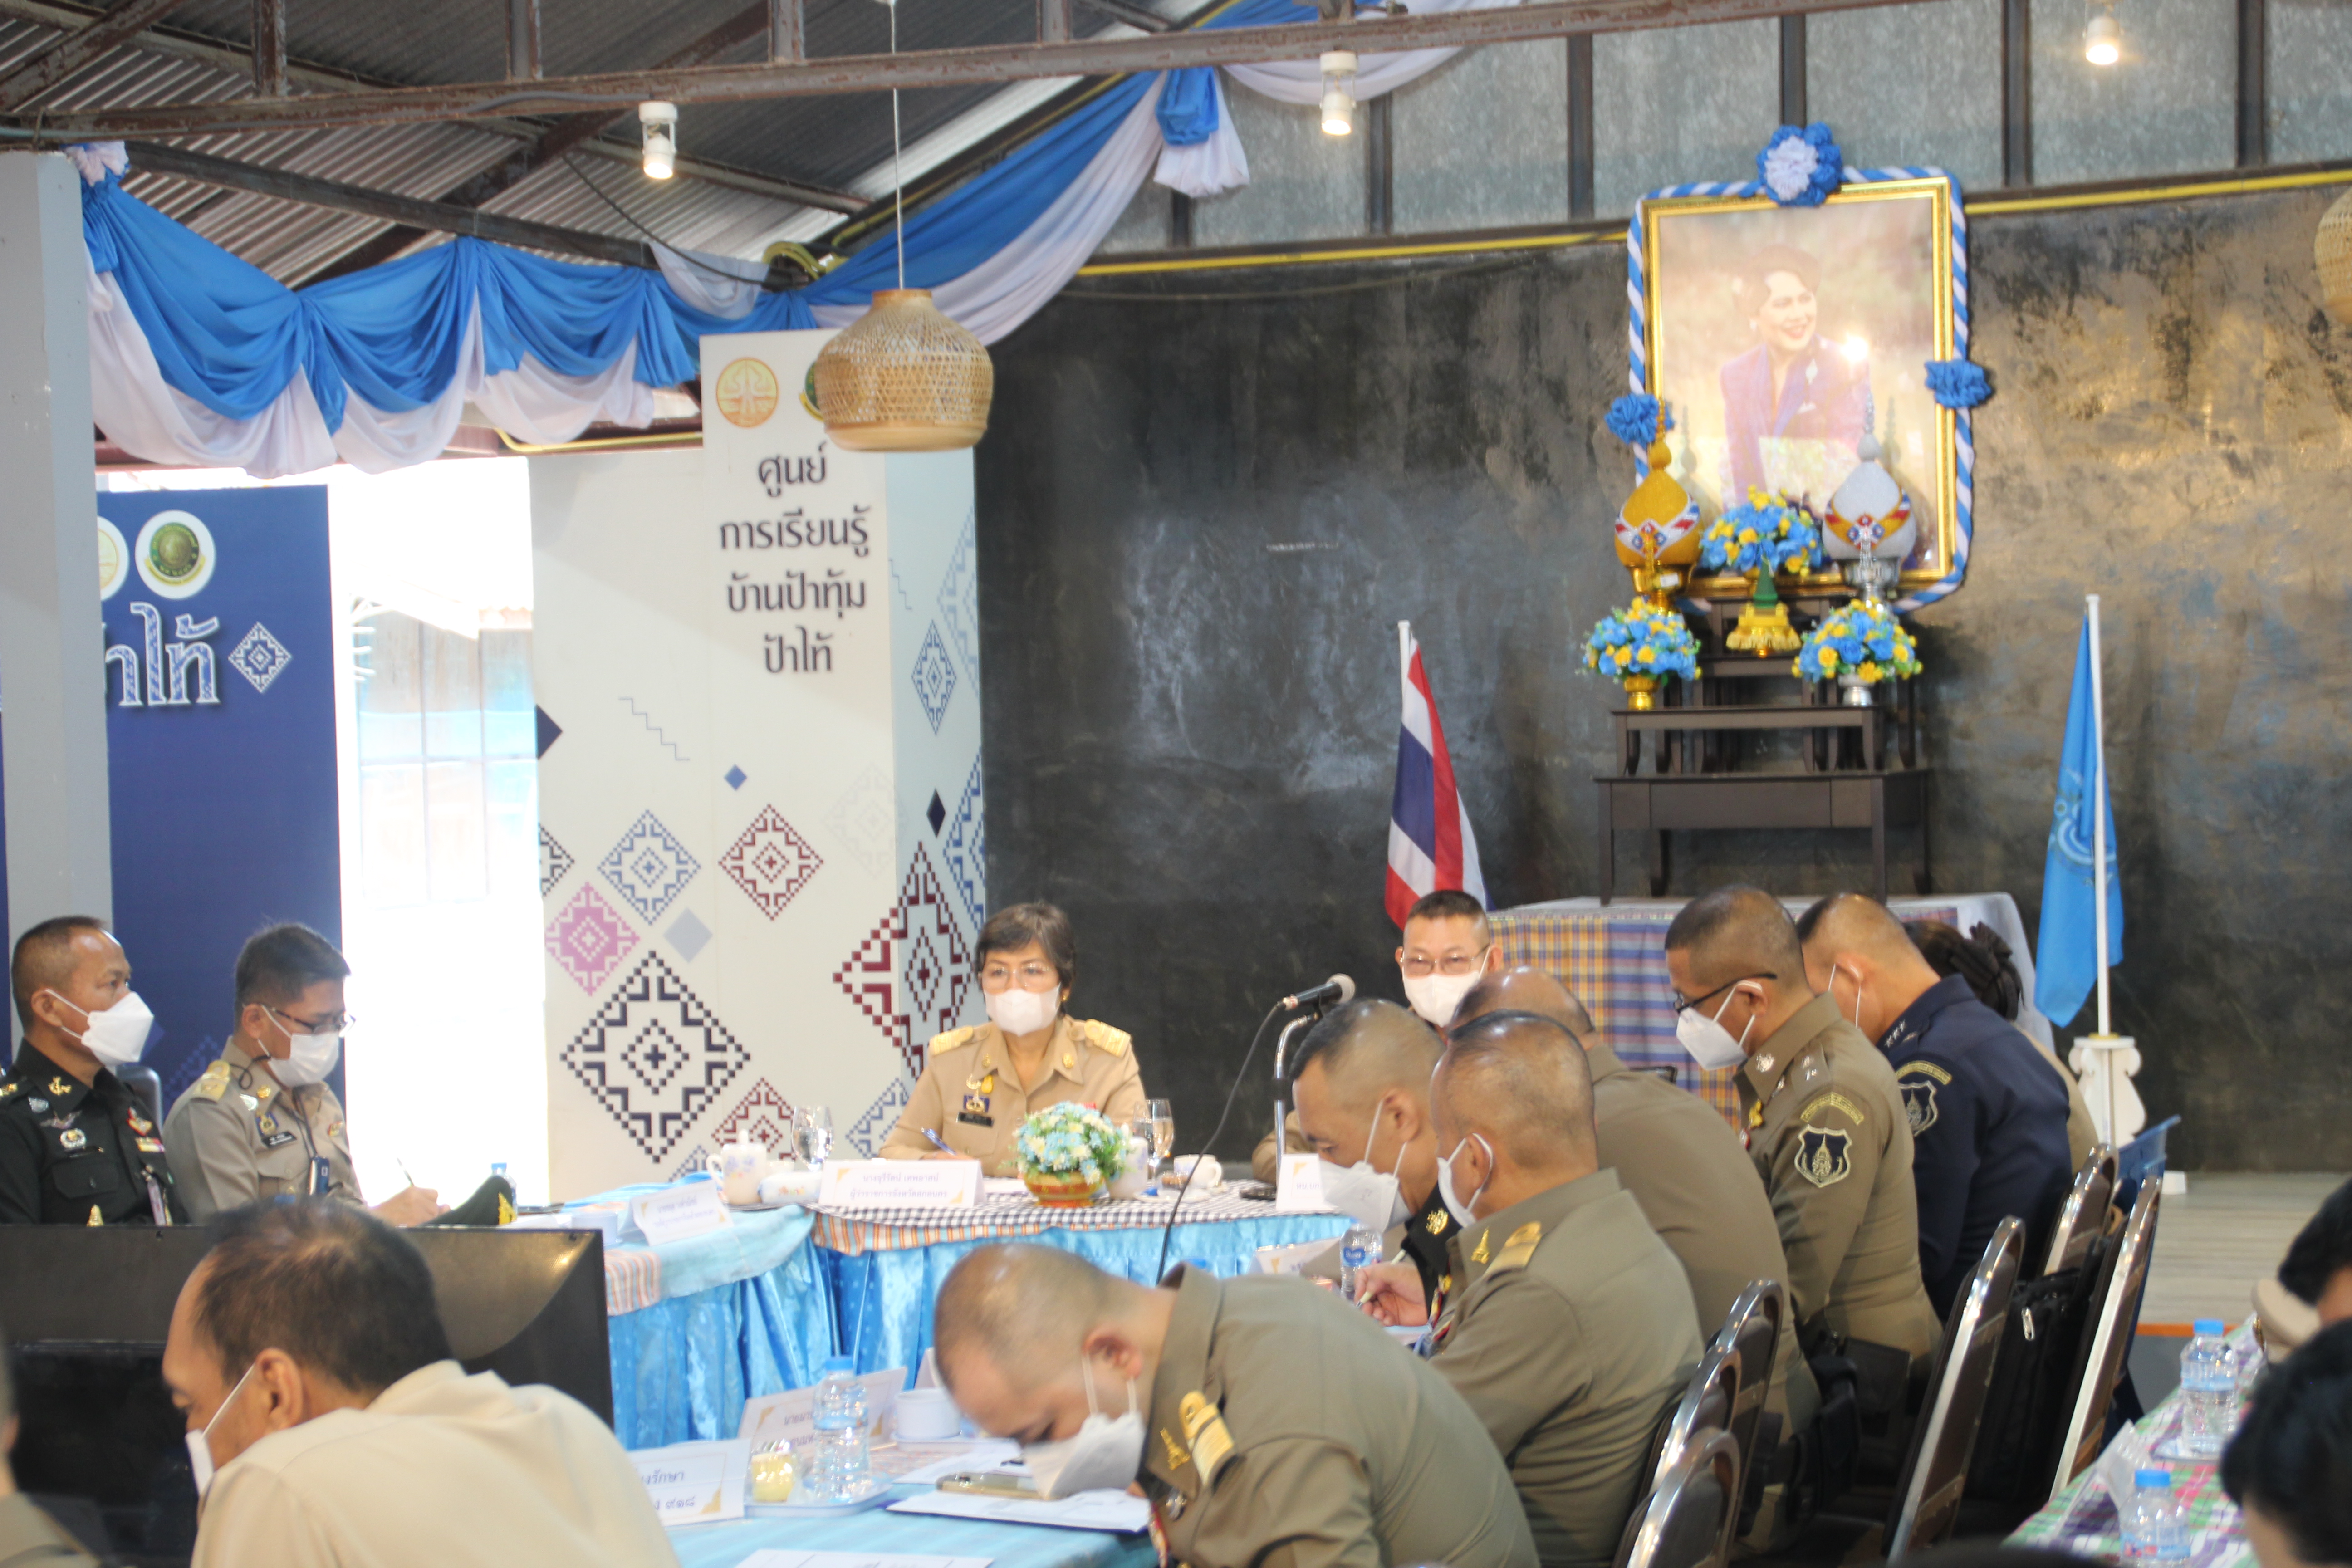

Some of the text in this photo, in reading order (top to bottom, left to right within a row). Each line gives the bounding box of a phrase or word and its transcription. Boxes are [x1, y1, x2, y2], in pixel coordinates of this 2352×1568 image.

[758, 441, 827, 497] ศูนย์
[720, 505, 871, 558] การเรียนรู้
[727, 568, 865, 618] บ้านป้าทุ้ม
[102, 602, 220, 706] าไท้
[764, 627, 833, 673] ป้าไท้
[640, 1468, 686, 1485] งรักษา
